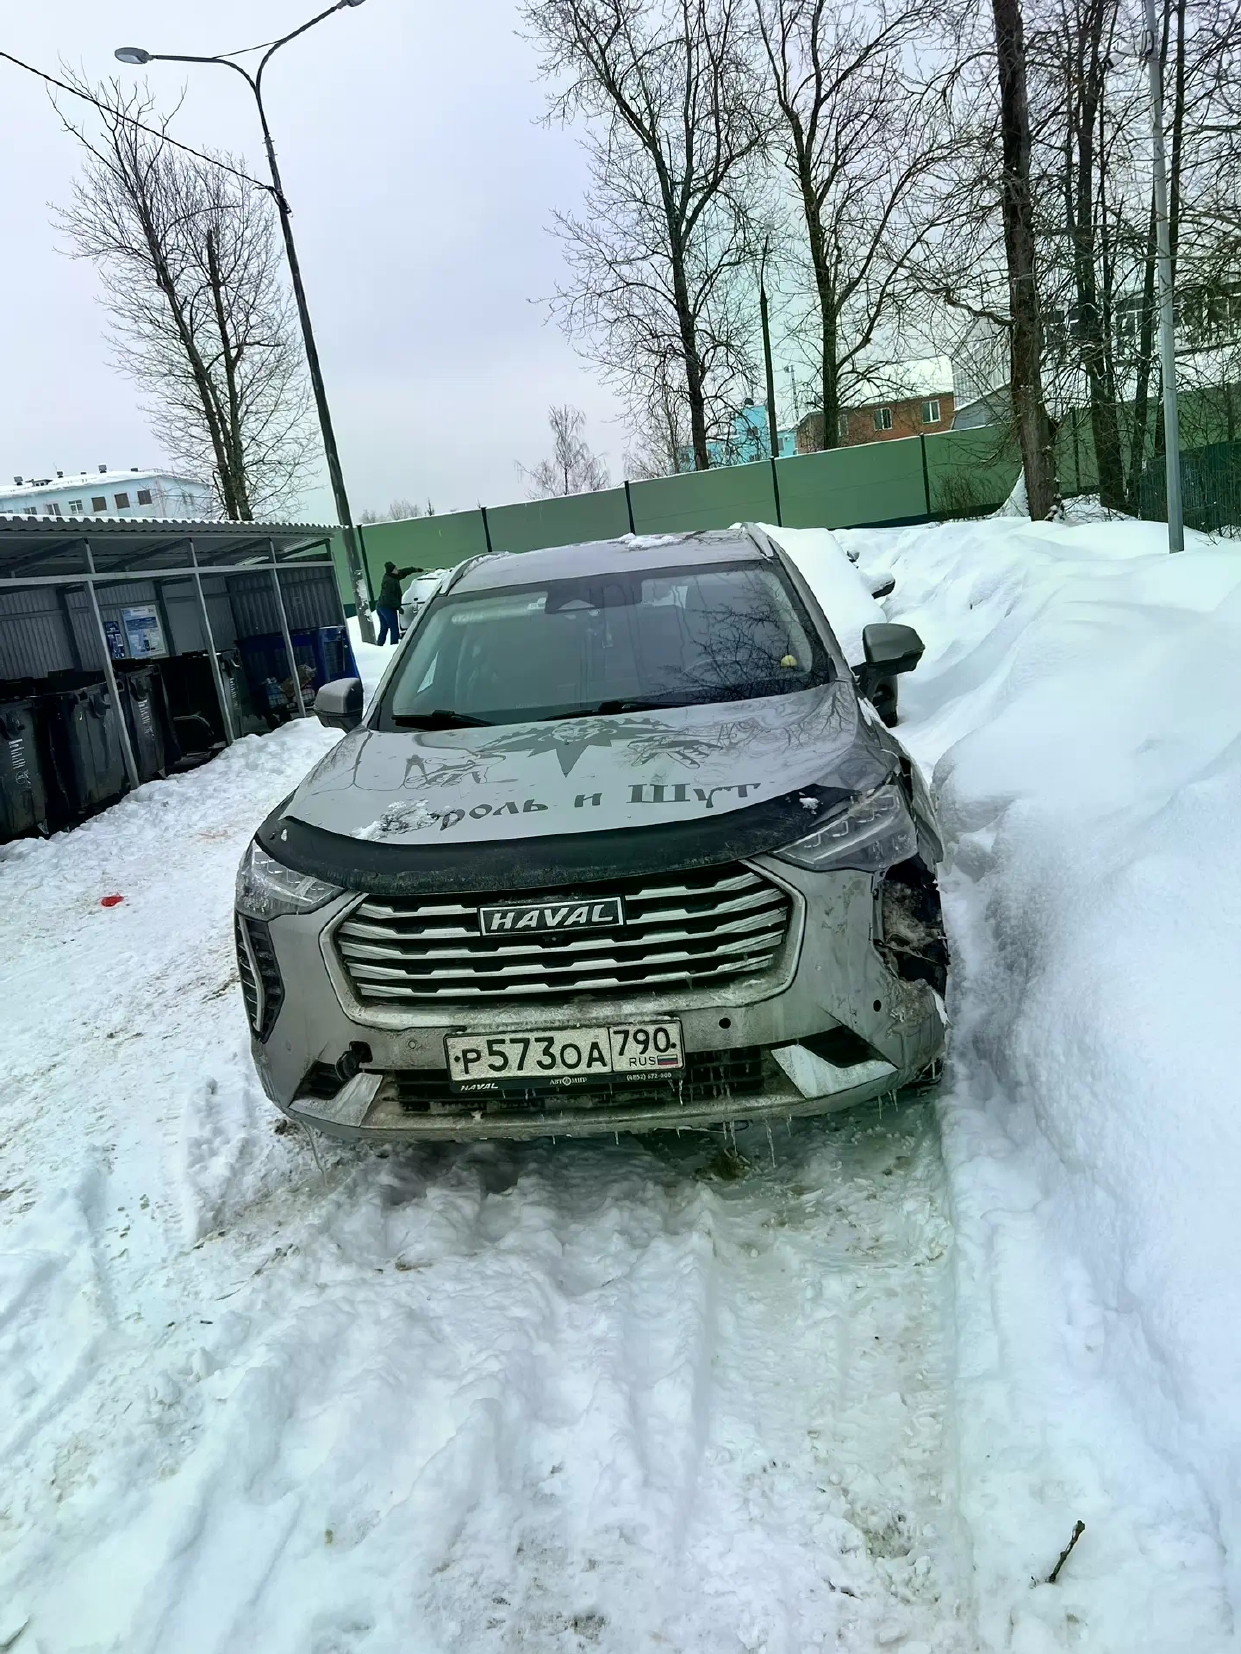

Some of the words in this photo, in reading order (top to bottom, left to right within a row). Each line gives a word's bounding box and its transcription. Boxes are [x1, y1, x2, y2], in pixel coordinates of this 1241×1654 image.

[626, 782, 762, 808] Шут
[490, 904, 614, 931] HAVAL
[612, 1027, 671, 1057] 790
[628, 1055, 656, 1067] RUS
[460, 1082, 499, 1092] HAVAL
